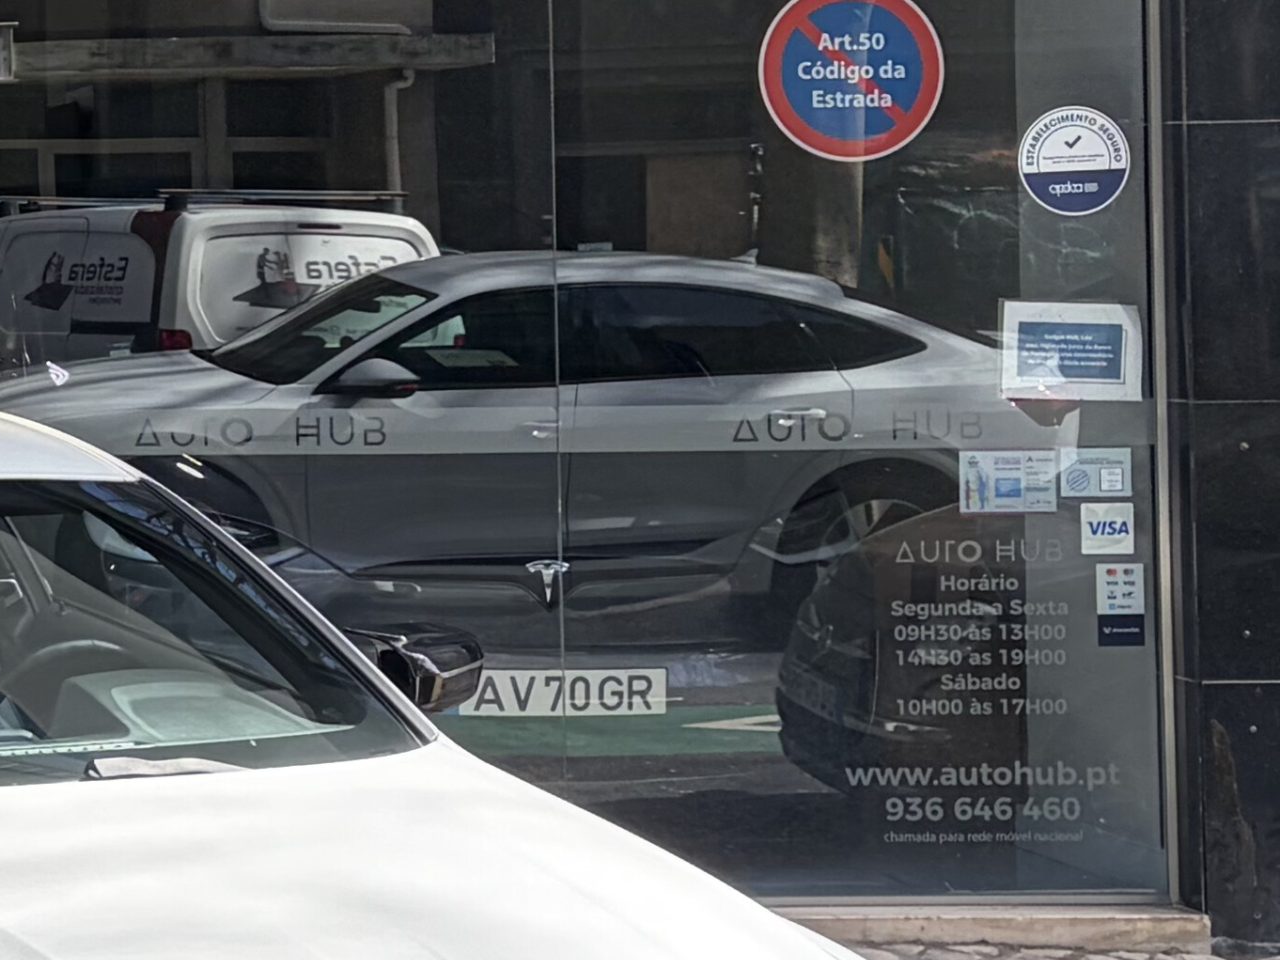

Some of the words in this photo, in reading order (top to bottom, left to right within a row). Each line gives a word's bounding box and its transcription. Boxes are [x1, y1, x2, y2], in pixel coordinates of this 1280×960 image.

[818, 33, 885, 51] Art.50
[797, 60, 873, 83] Código
[879, 60, 906, 79] da
[812, 89, 892, 109] Estrada
[1026, 113, 1097, 166] ESTABELECIMENTO
[1098, 124, 1123, 163] SEGURO
[296, 417, 387, 446] HUB
[892, 410, 983, 440] HUB
[1087, 521, 1129, 536] VISA
[996, 539, 1063, 562] HUB
[940, 574, 1019, 591] Horário
[890, 600, 984, 620] Segunda
[1010, 600, 1069, 616] Sexta
[894, 624, 962, 641] 09H30
[999, 624, 1066, 640] 13H00
[896, 649, 962, 666] 14H30
[999, 649, 1066, 666] 19H00
[940, 673, 1021, 690] Sábado
[897, 699, 963, 715] 10H00
[970, 698, 993, 715] às
[1000, 699, 1067, 715] 17H00
[845, 760, 1119, 791] www.autohub.pt
[885, 797, 944, 821] 936
[953, 797, 1013, 821] 646
[1022, 797, 1081, 821] 460
[883, 831, 936, 842] chamada
[938, 832, 964, 844] para
[967, 831, 993, 842] rede
